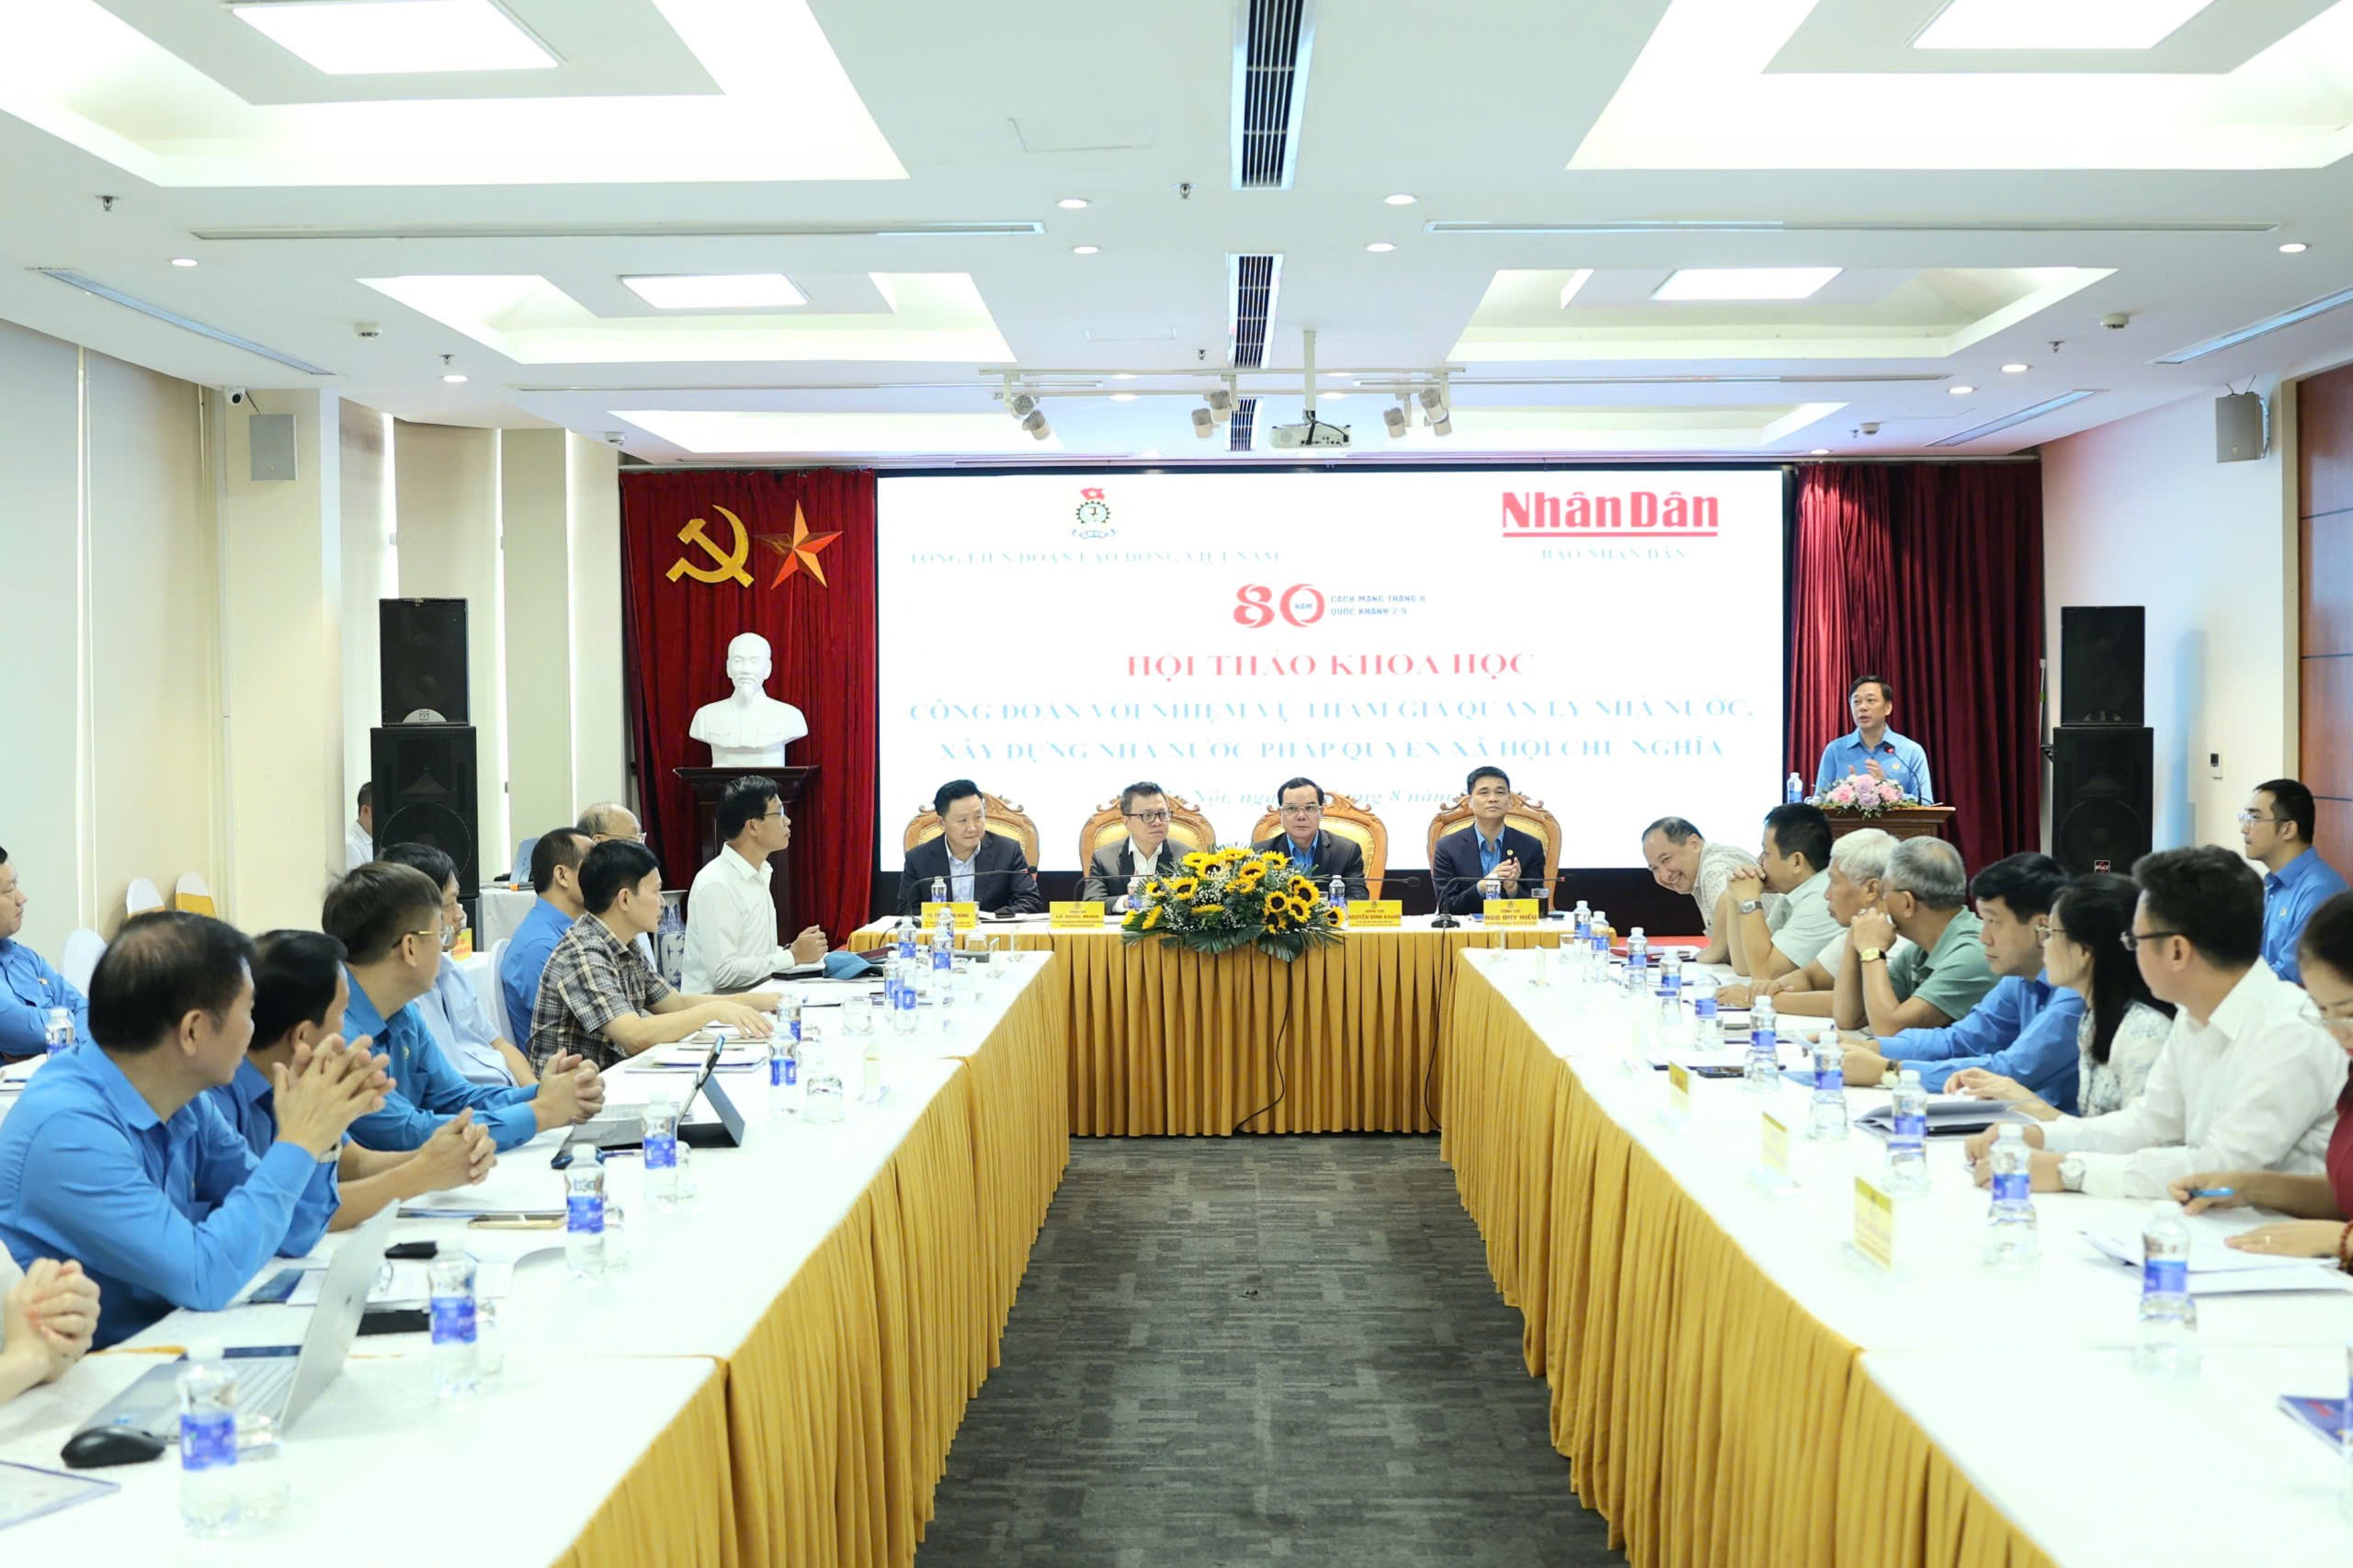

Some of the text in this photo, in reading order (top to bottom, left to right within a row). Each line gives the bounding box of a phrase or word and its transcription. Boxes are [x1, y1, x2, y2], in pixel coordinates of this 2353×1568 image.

[1501, 491, 1720, 528] Nhân Dân
[1233, 583, 1325, 628] 80
[1330, 653, 1440, 676] KHOA
[1452, 653, 1535, 681] HỌC
[1397, 700, 1449, 720] GIA
